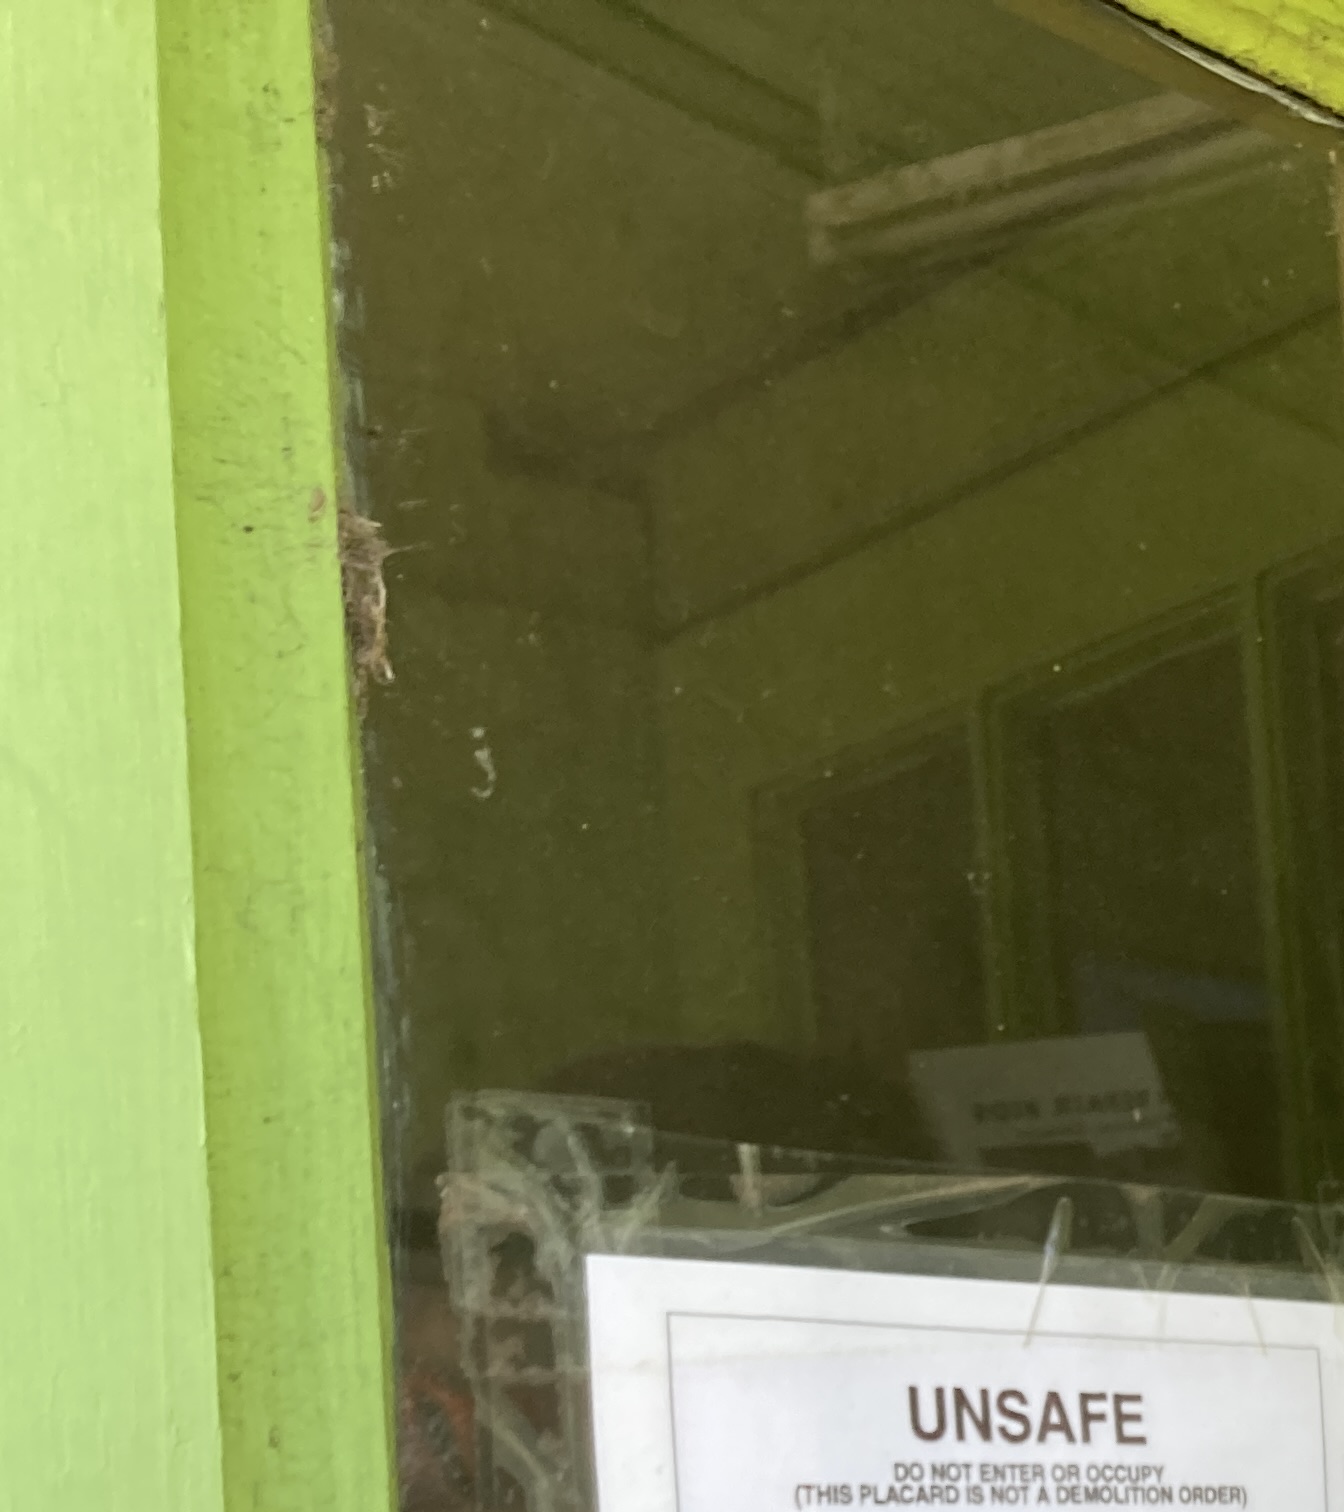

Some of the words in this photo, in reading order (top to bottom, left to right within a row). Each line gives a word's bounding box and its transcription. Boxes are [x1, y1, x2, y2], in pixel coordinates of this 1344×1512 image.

[907, 1384, 1148, 1446] UNSAFE
[893, 1462, 924, 1482] DO
[932, 1462, 972, 1483] NOT
[980, 1463, 1045, 1483] ENTER
[1051, 1464, 1080, 1484] OR
[1086, 1464, 1165, 1485] OCCUPY
[795, 1484, 853, 1508] (THIS
[859, 1485, 960, 1505] PLACARD
[966, 1485, 985, 1504] IS
[990, 1485, 1032, 1504] NOT
[1037, 1486, 1050, 1504] A
[1056, 1485, 1173, 1505] DEMOLITION
[1178, 1486, 1249, 1509] ORDER)
